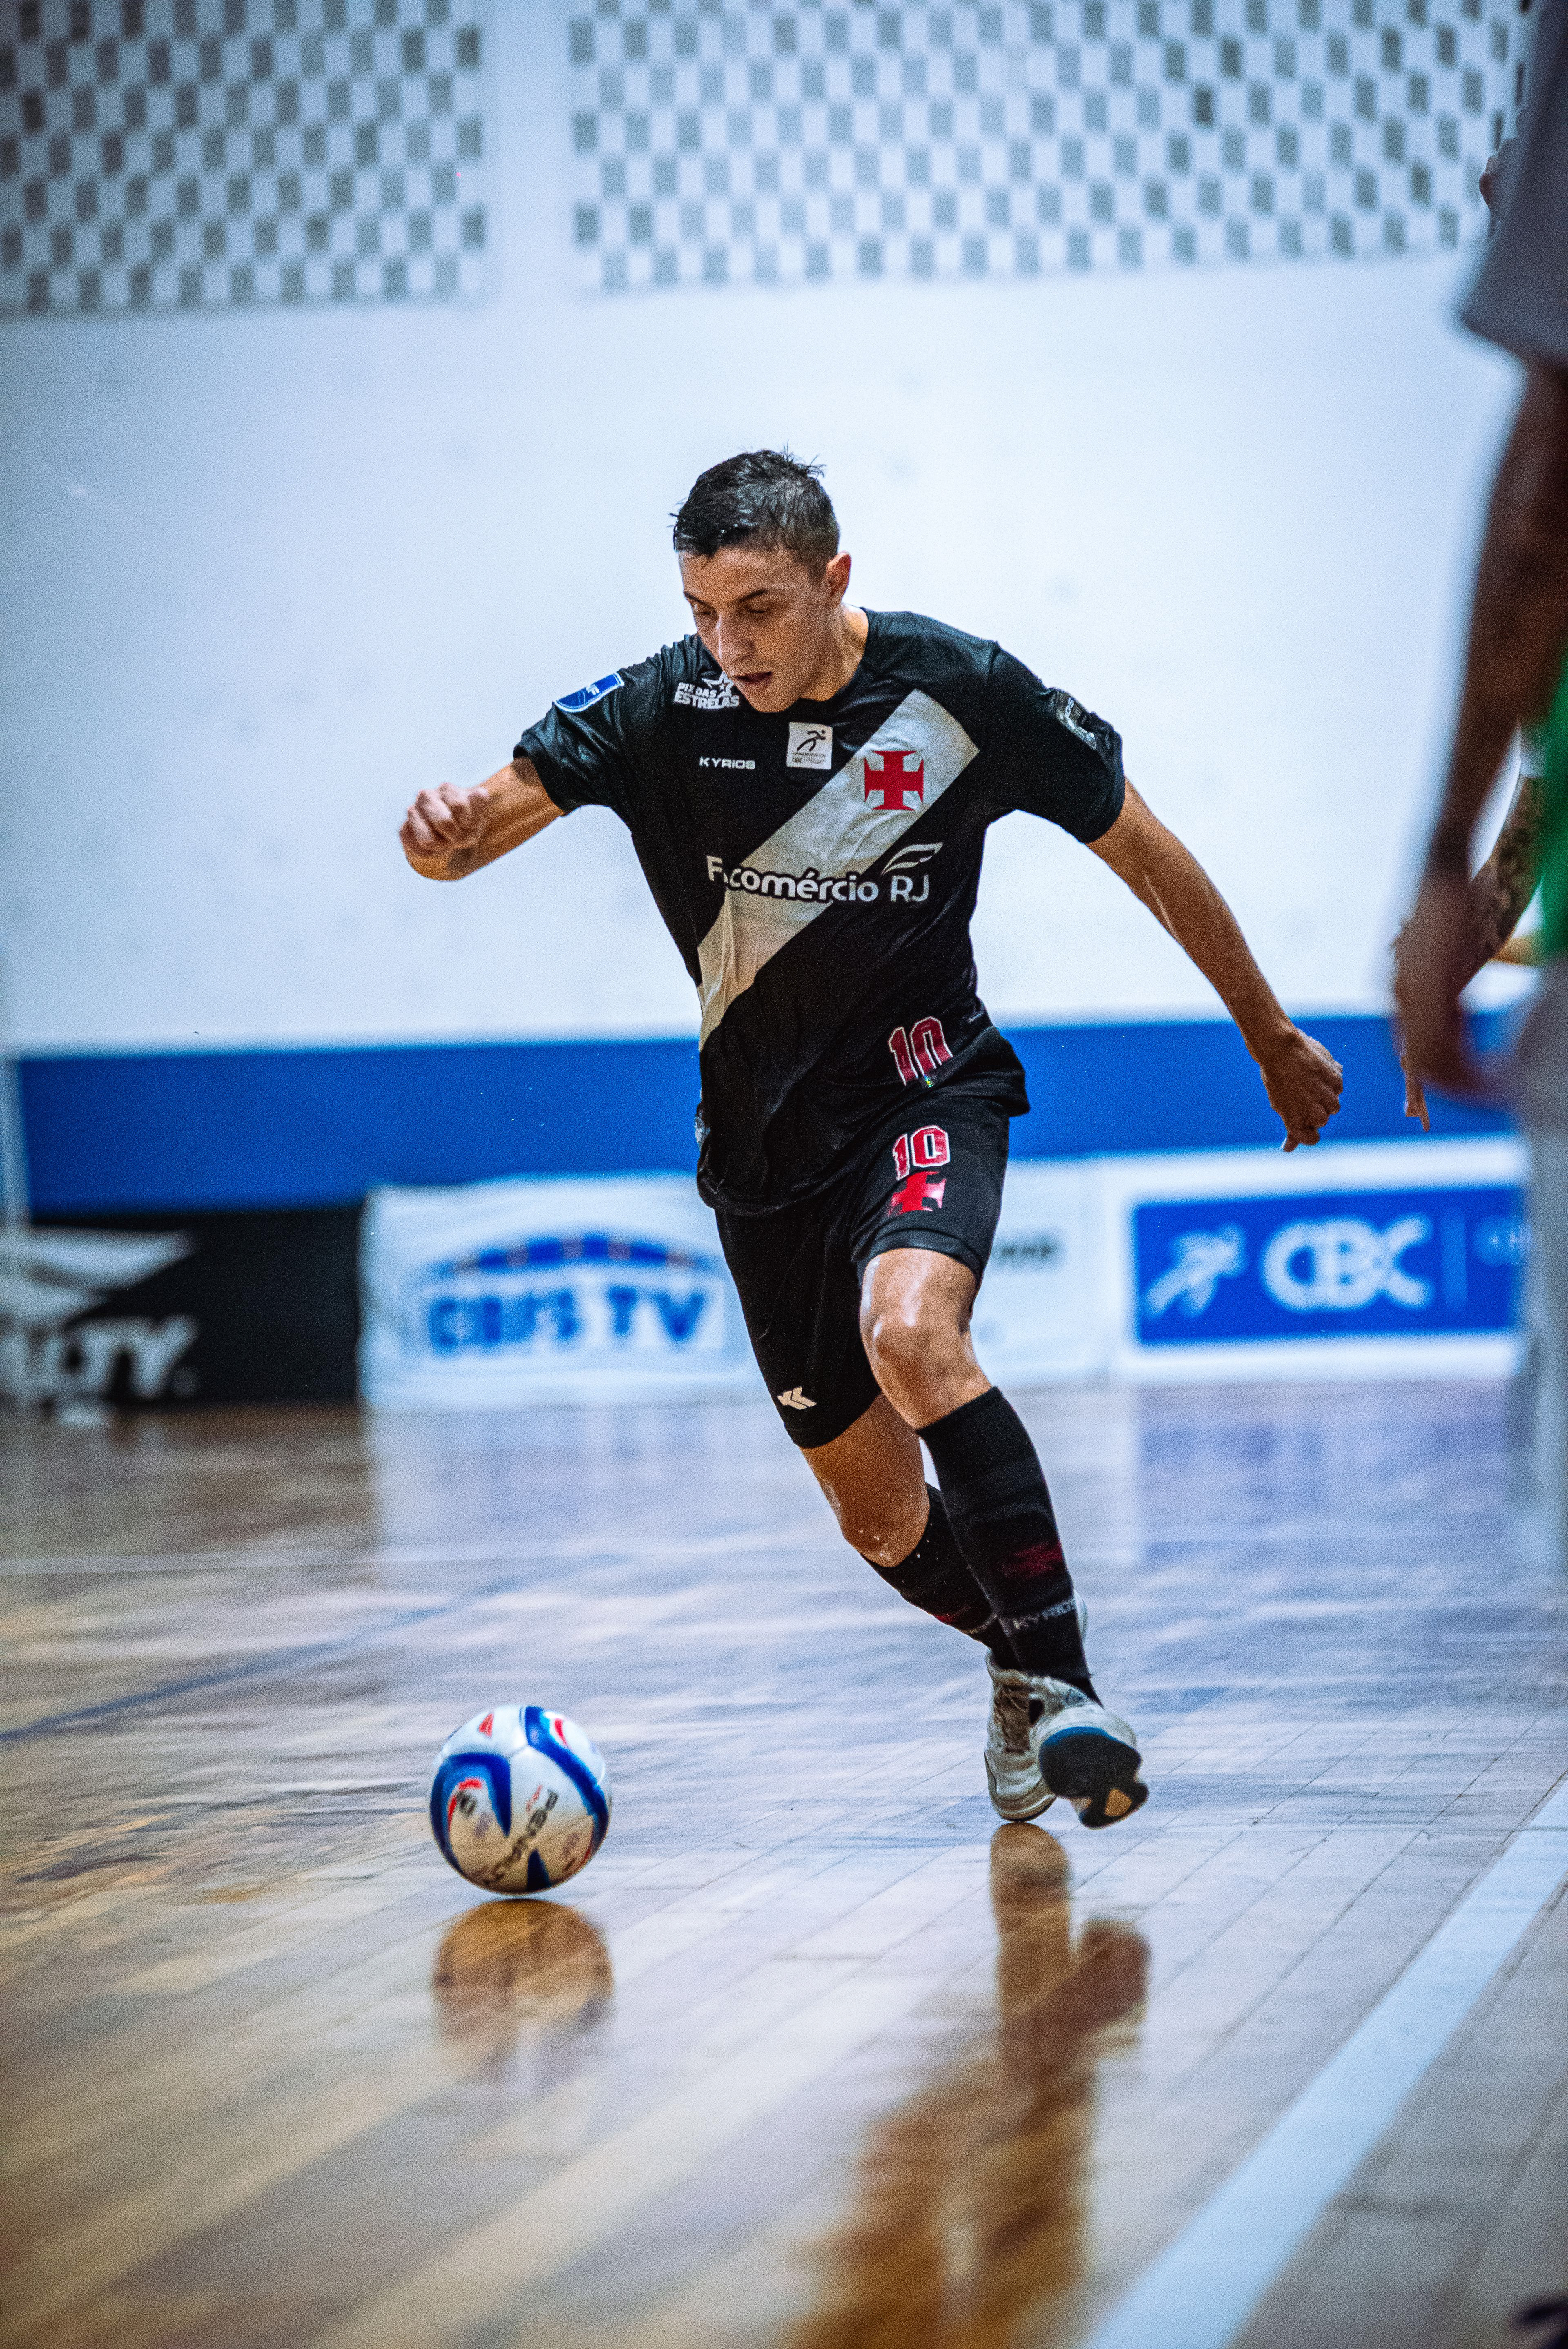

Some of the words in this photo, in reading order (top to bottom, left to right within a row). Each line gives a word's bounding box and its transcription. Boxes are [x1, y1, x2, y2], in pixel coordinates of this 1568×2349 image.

[674, 691, 740, 710] ESTRELAS
[677, 682, 695, 693] PIX
[695, 687, 717, 698] DAS
[699, 756, 755, 769] KYRIOS
[890, 874, 930, 903] RJ
[888, 1016, 953, 1086] 10
[892, 1124, 951, 1181] 10
